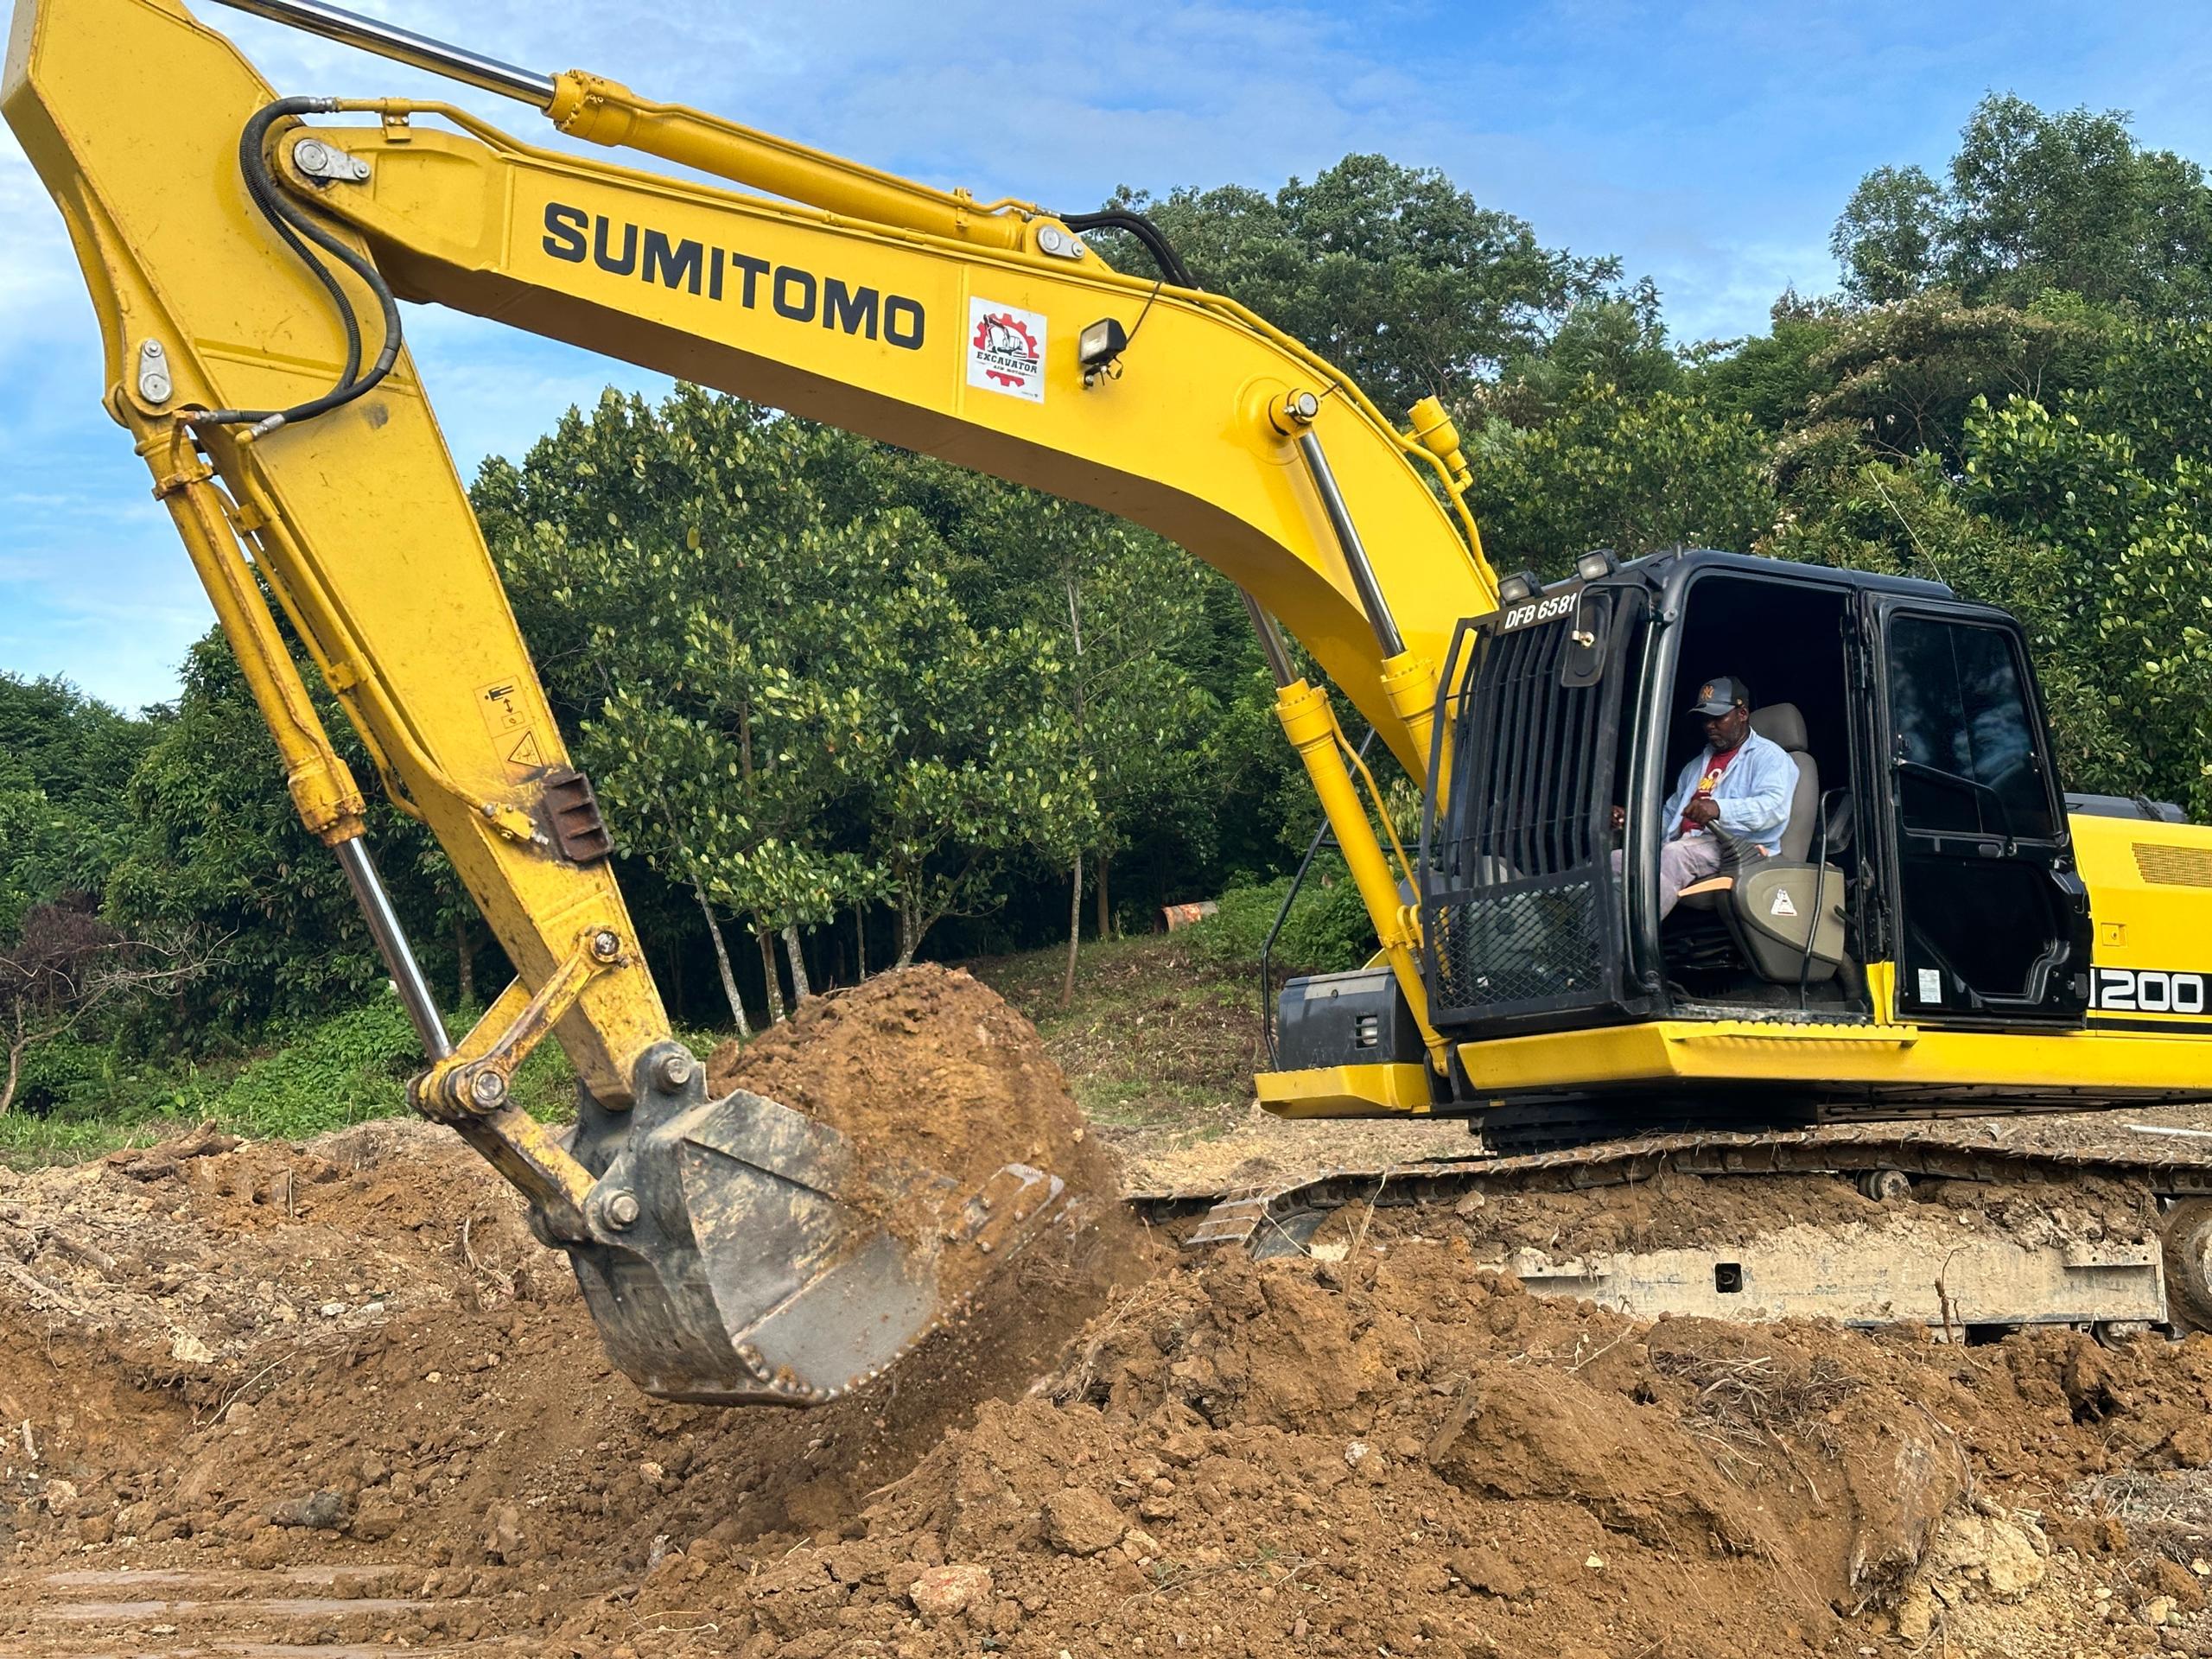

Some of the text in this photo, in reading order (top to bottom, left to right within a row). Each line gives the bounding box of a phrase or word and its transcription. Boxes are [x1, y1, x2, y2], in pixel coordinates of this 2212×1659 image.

[543, 201, 925, 351] SUMITOMO
[976, 352, 1038, 373] EXCAVATOR
[1504, 592, 1577, 630] DFB 6581
